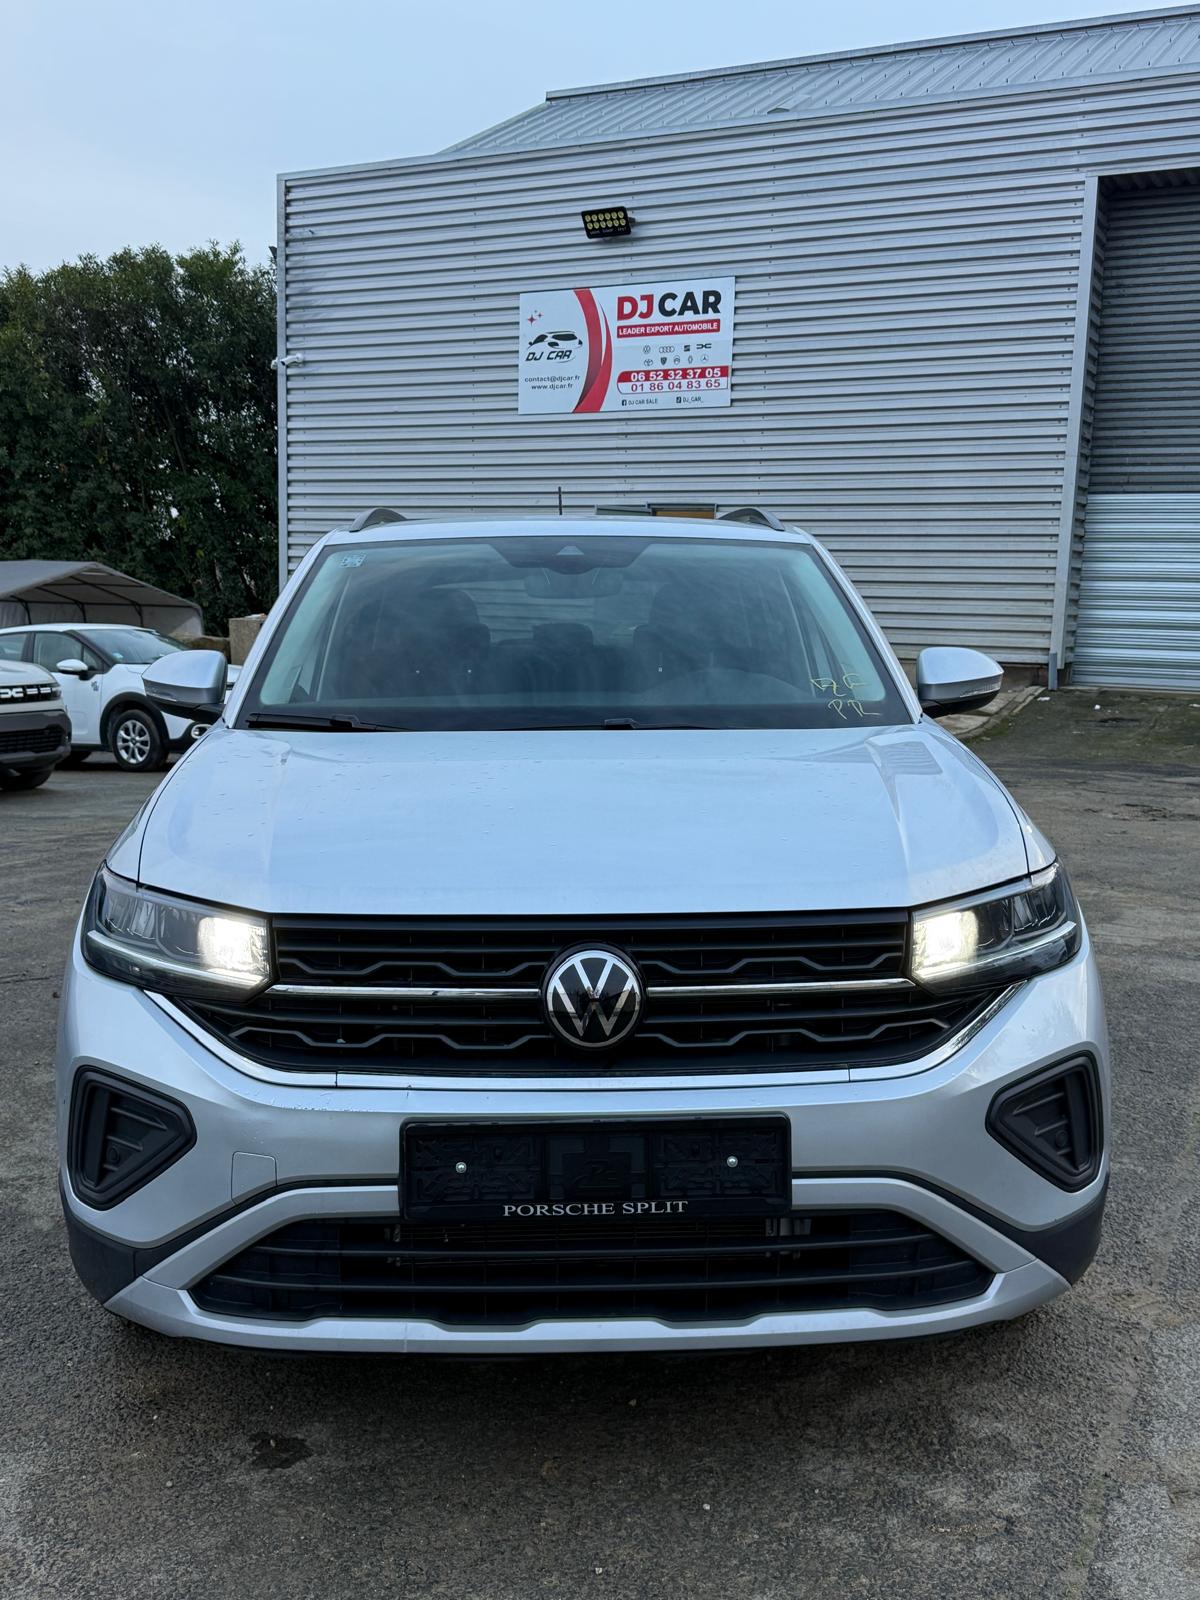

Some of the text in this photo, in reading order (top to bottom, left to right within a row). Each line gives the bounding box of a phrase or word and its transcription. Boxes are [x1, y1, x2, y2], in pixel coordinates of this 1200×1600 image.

[617, 290, 722, 321] DJ CAR
[619, 322, 718, 335] LEADER EXPORT AUTOMOBILE
[525, 349, 572, 362] DJ CAR
[524, 375, 580, 383] contact@djcar.fr
[630, 368, 721, 382] 06 52 32 37 05
[531, 383, 573, 391] www.djcar.fr
[631, 379, 721, 393] 01 86 04 83 65
[502, 1200, 688, 1217] PORSCHE SPLIT
